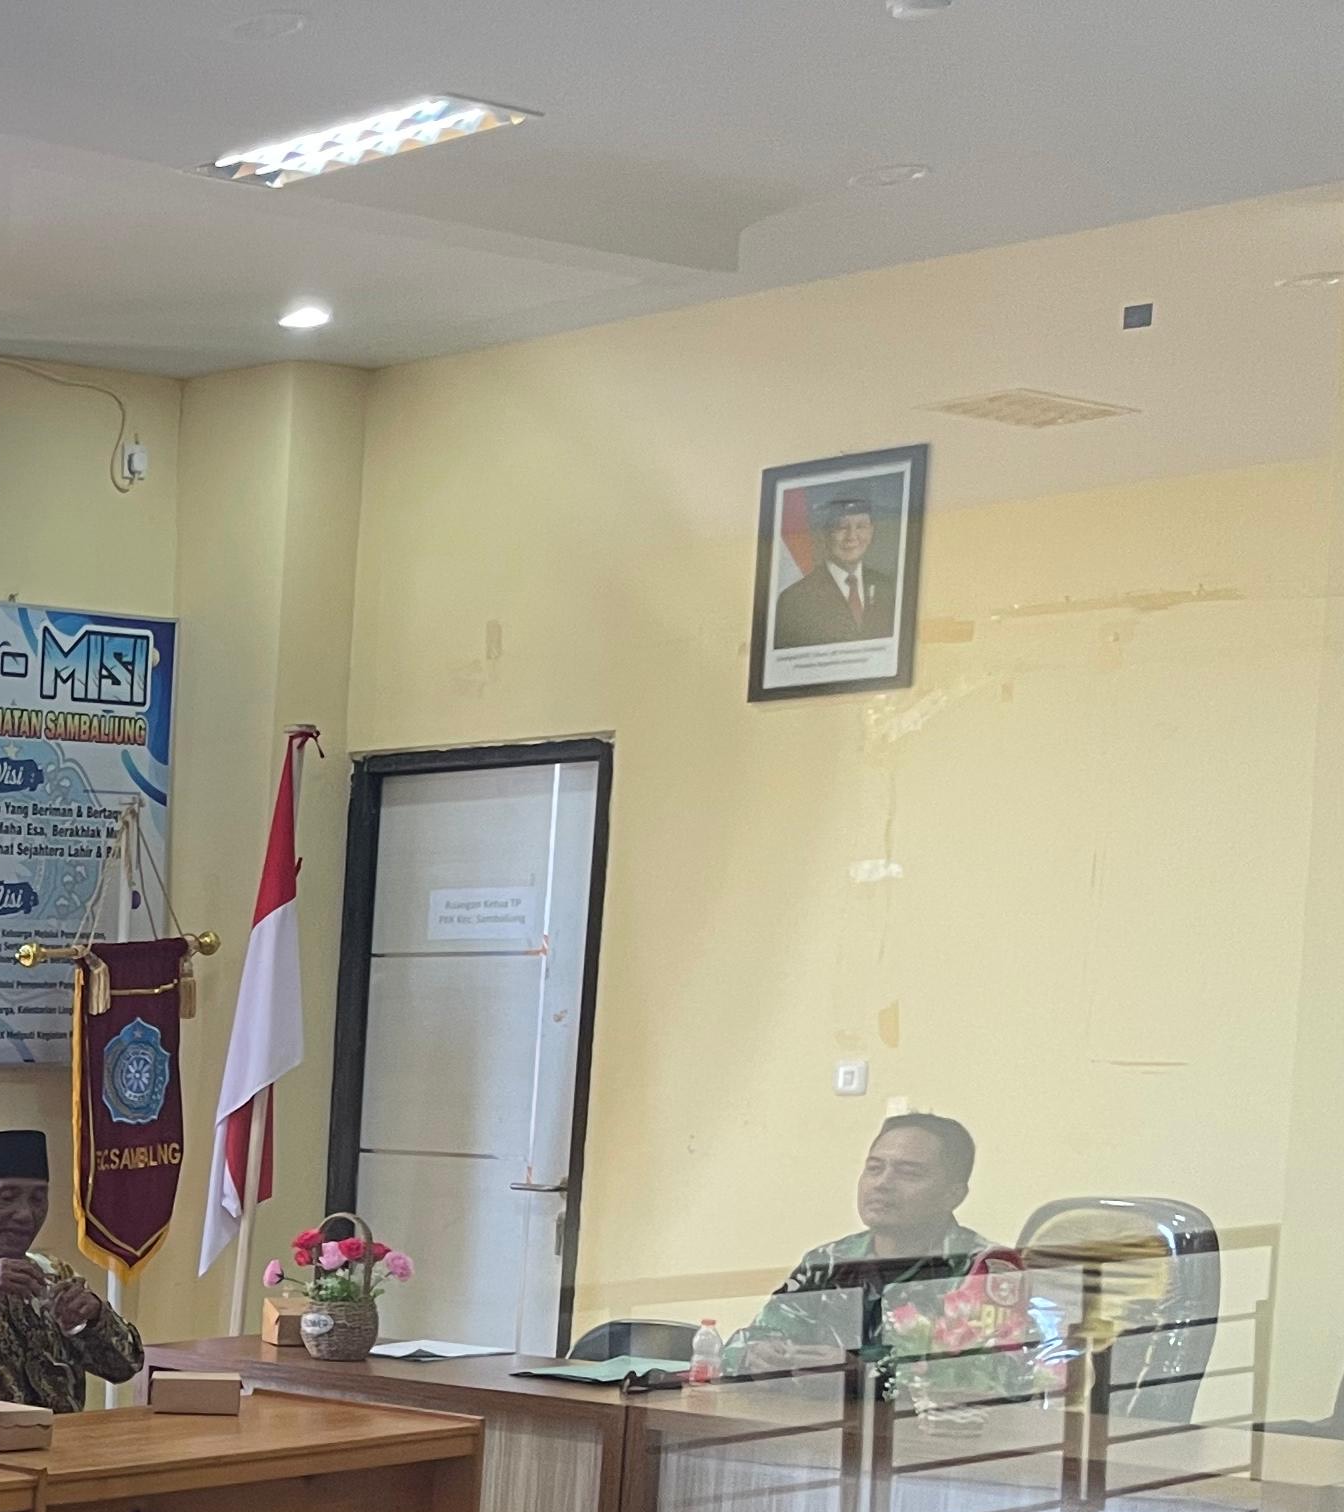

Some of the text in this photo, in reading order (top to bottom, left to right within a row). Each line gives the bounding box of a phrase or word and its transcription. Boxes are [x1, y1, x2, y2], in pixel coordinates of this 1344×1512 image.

[40, 624, 151, 707] MISI
[44, 710, 146, 746] SAMBALIUNG
[5, 802, 29, 819] Yang
[32, 804, 73, 818] Beriman
[17, 842, 64, 859] Sejahtera
[68, 844, 93, 858] Lahir
